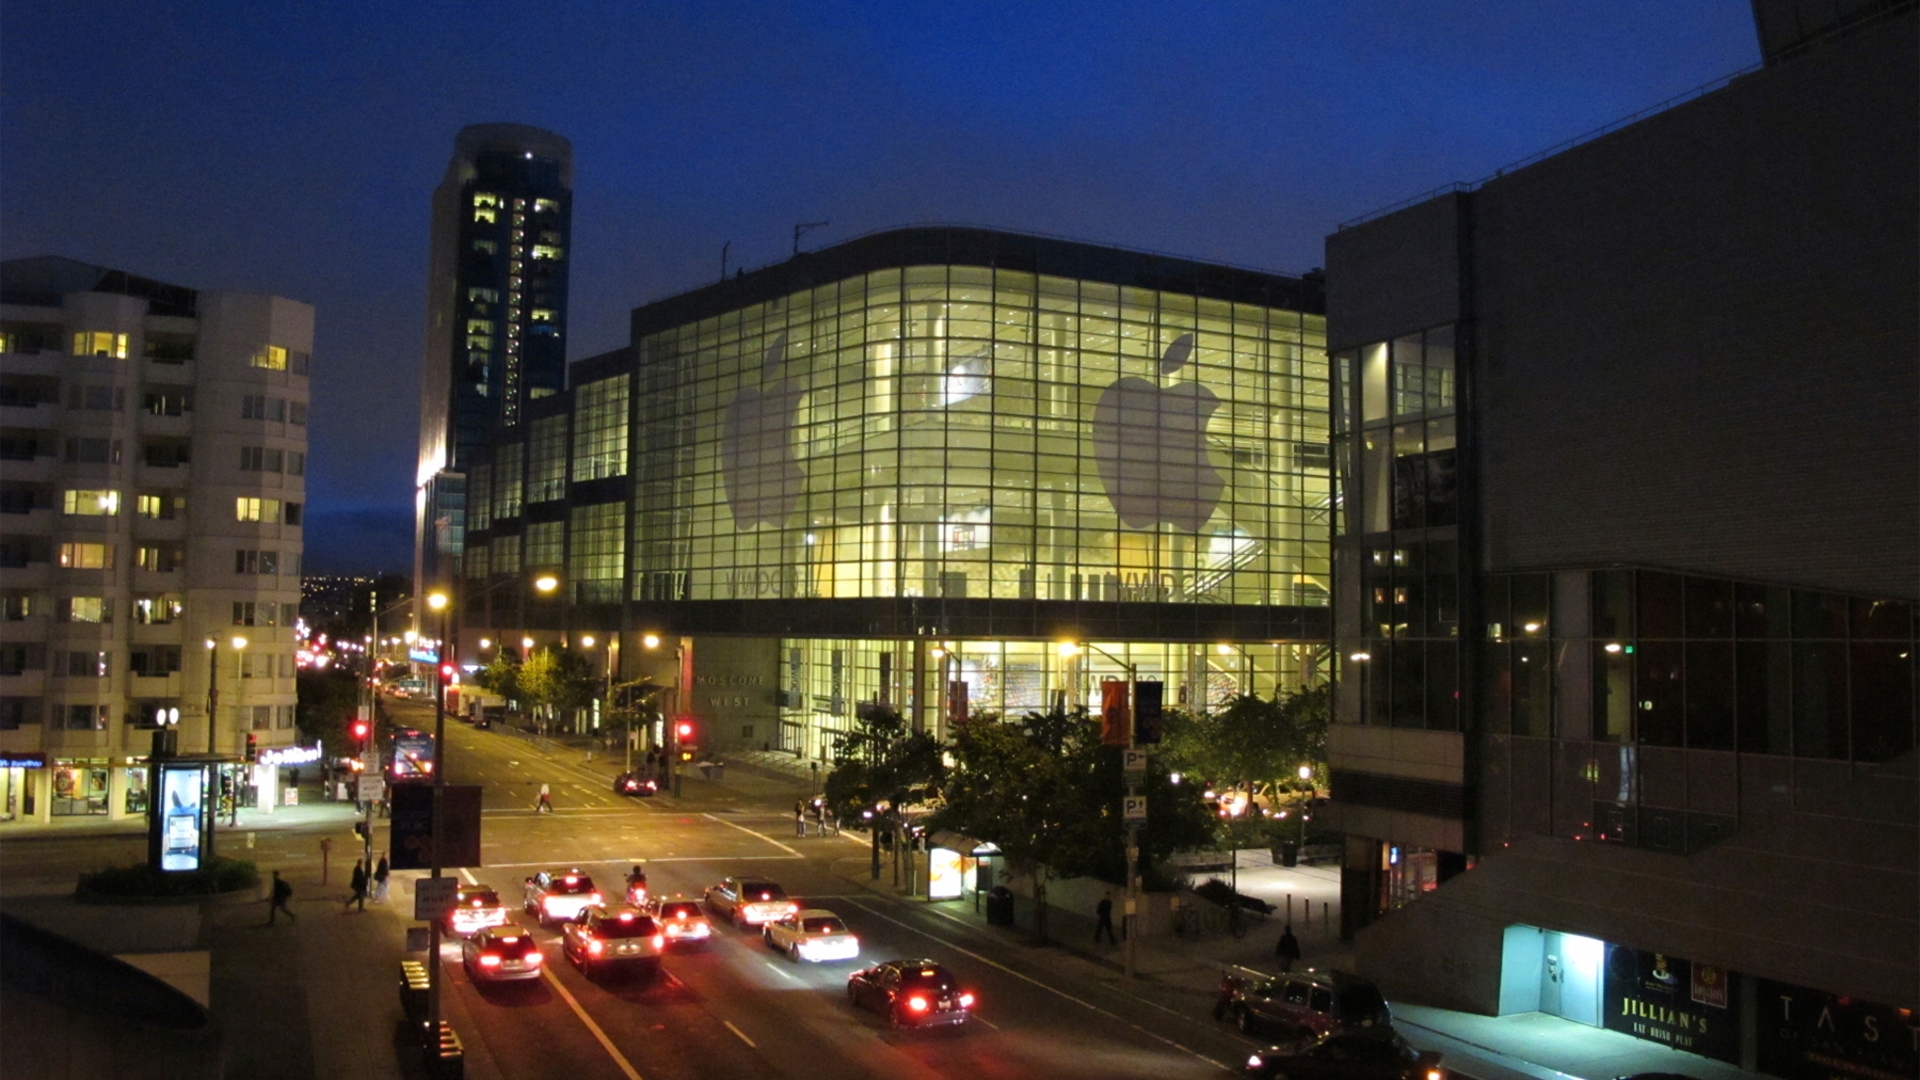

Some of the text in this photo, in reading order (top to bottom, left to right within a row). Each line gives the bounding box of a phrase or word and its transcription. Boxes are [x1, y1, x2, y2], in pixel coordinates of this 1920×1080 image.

[696, 675, 764, 686] MOSCONE
[710, 697, 750, 706] WEST
[1126, 753, 1137, 767] P
[1126, 800, 1137, 814] P
[1621, 997, 1708, 1034] JILLIAN'S
[1675, 1034, 1693, 1048] PLAY
